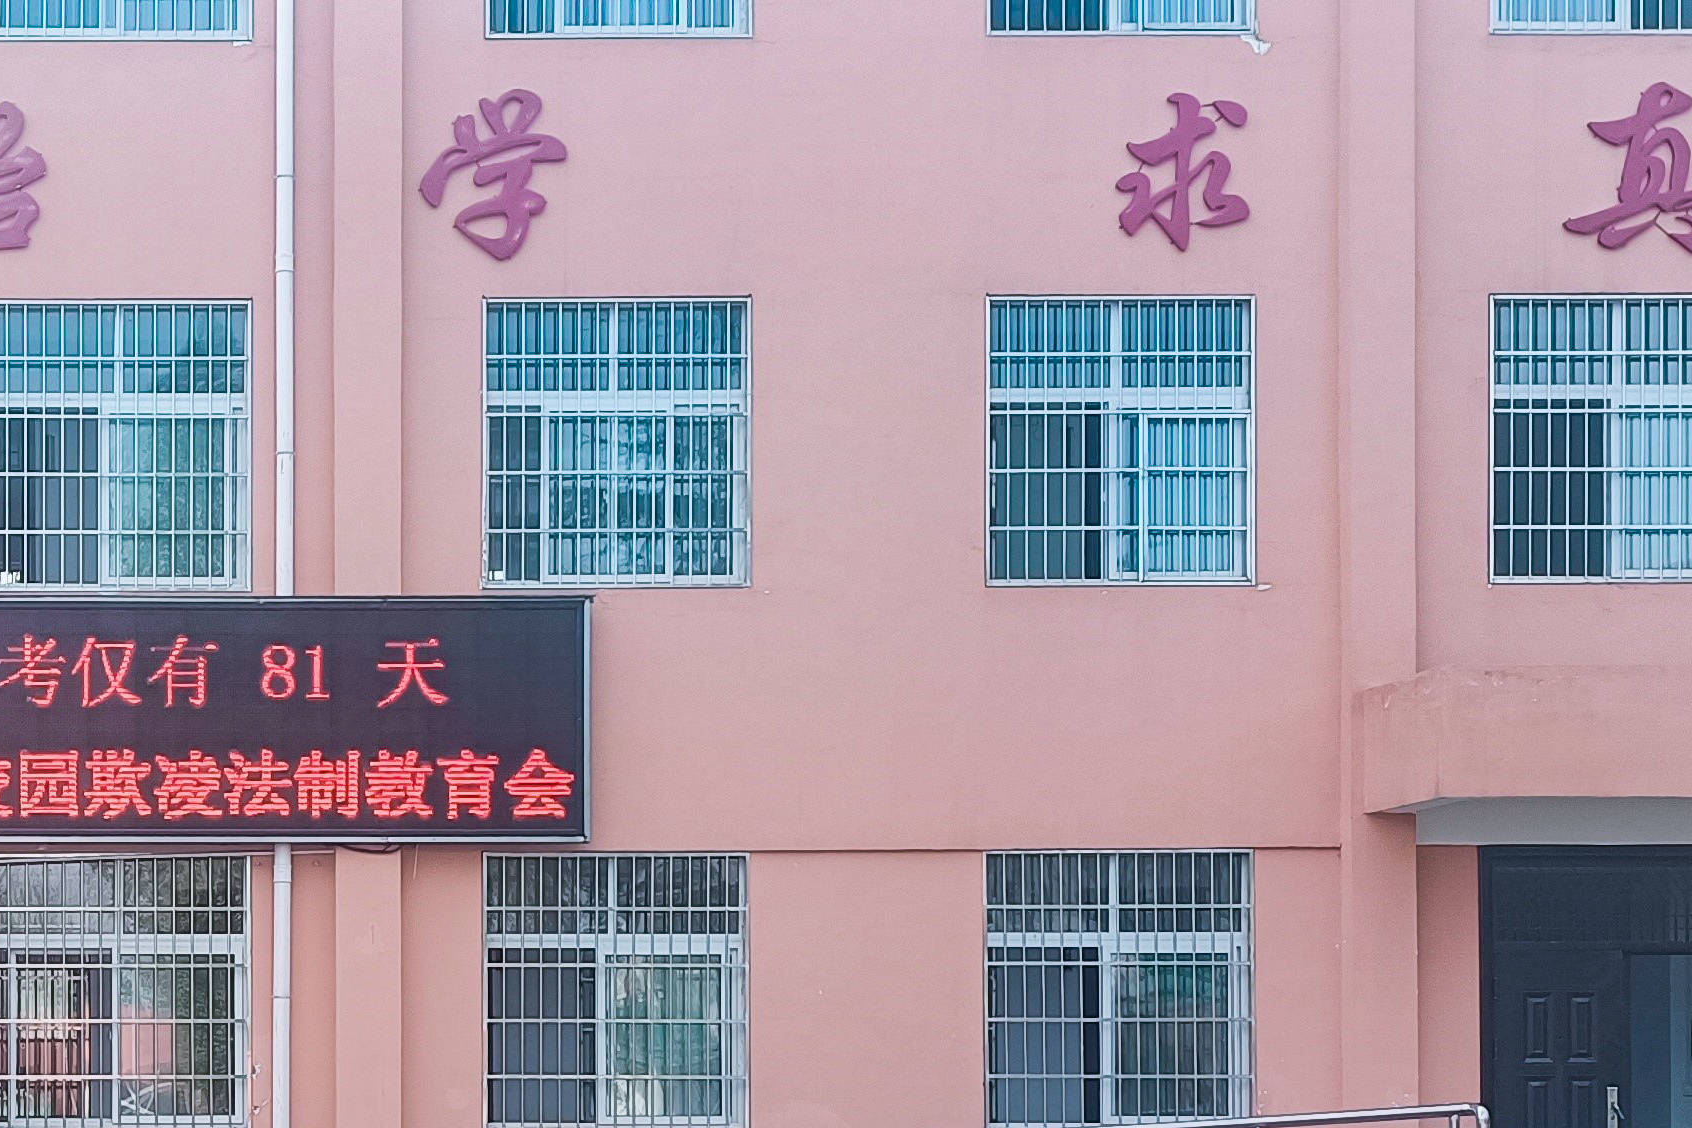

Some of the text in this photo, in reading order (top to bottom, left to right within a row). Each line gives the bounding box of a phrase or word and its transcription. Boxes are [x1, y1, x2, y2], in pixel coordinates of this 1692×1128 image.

[417, 88, 567, 260] 学
[1116, 93, 1251, 252] 求
[261, 644, 330, 700] 81
[377, 638, 448, 708] 天
